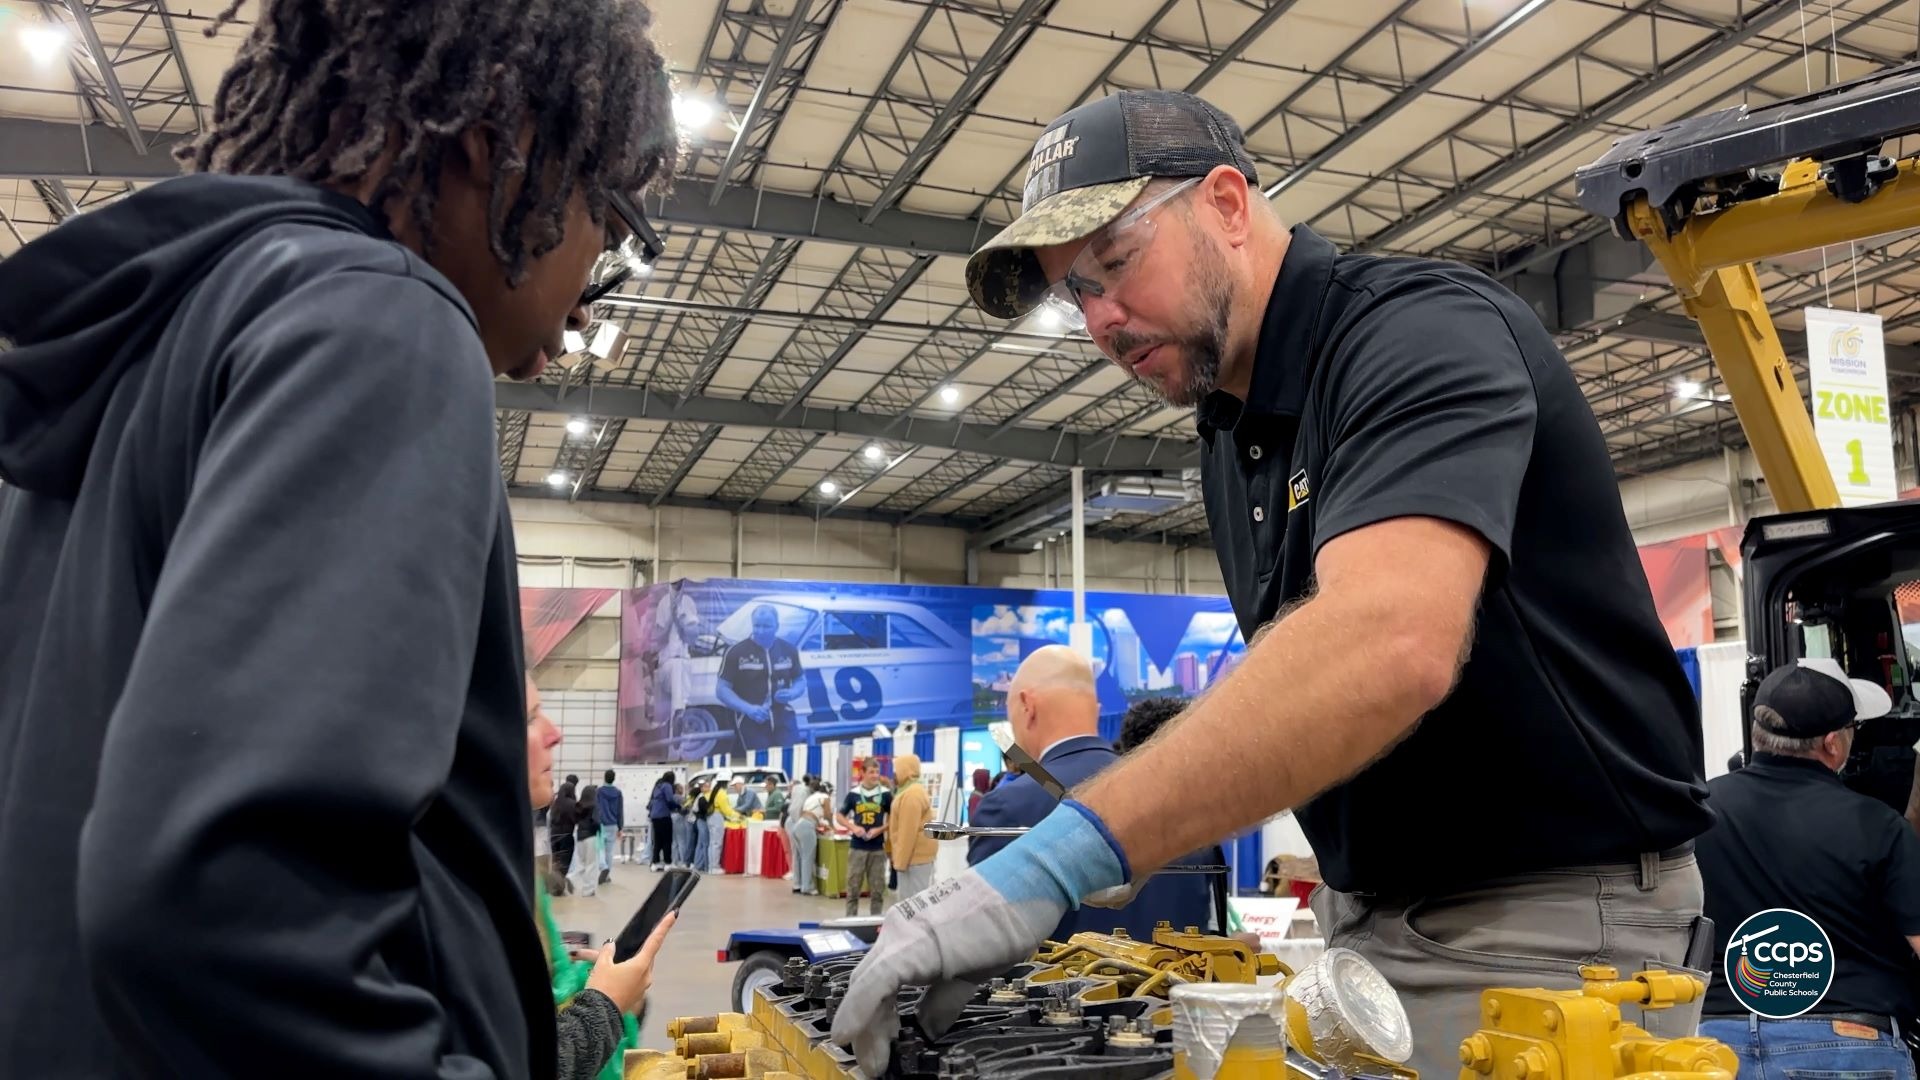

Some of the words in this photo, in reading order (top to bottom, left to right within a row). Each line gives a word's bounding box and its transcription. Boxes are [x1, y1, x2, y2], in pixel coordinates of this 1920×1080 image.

[1829, 357, 1867, 368] MISSION
[1816, 391, 1889, 425] ZONE
[1846, 439, 1871, 486] 1
[1294, 477, 1309, 500] CAT
[805, 666, 883, 724] 19
[861, 812, 875, 825] 15
[1242, 912, 1278, 926] Energy
[1254, 927, 1281, 938] Team
